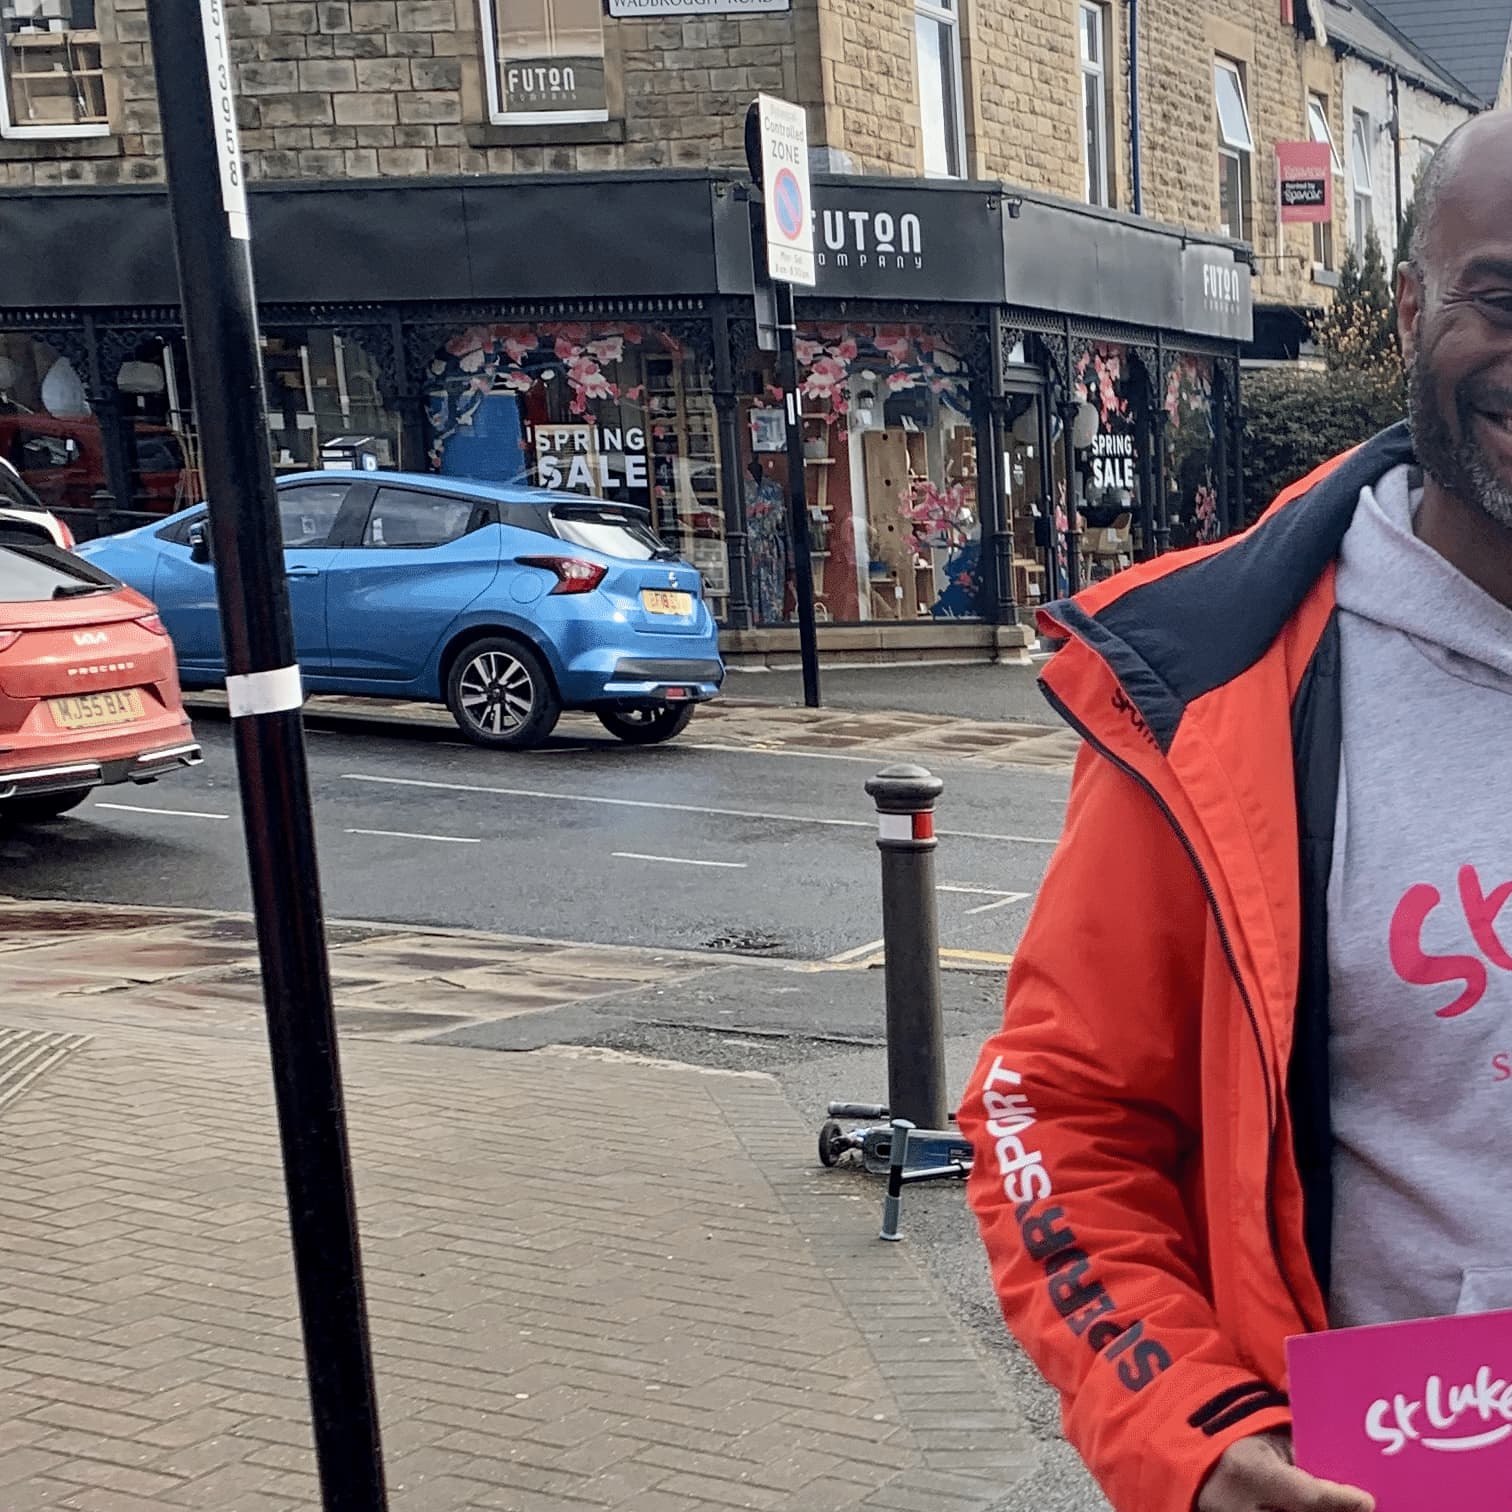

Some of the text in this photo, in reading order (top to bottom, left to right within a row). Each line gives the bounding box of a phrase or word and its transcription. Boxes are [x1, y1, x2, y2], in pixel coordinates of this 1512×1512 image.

[508, 66, 576, 93] FUTON
[771, 139, 800, 165] ZONE
[818, 253, 922, 270] OMPANY
[1203, 263, 1240, 303] FUTON
[536, 427, 646, 451] SPRING
[1091, 433, 1132, 457] SPRING
[540, 455, 648, 489] SALE
[1093, 458, 1134, 489] SALE
[982, 1056, 1053, 1203] SPORT
[1364, 1393, 1423, 1456] St
